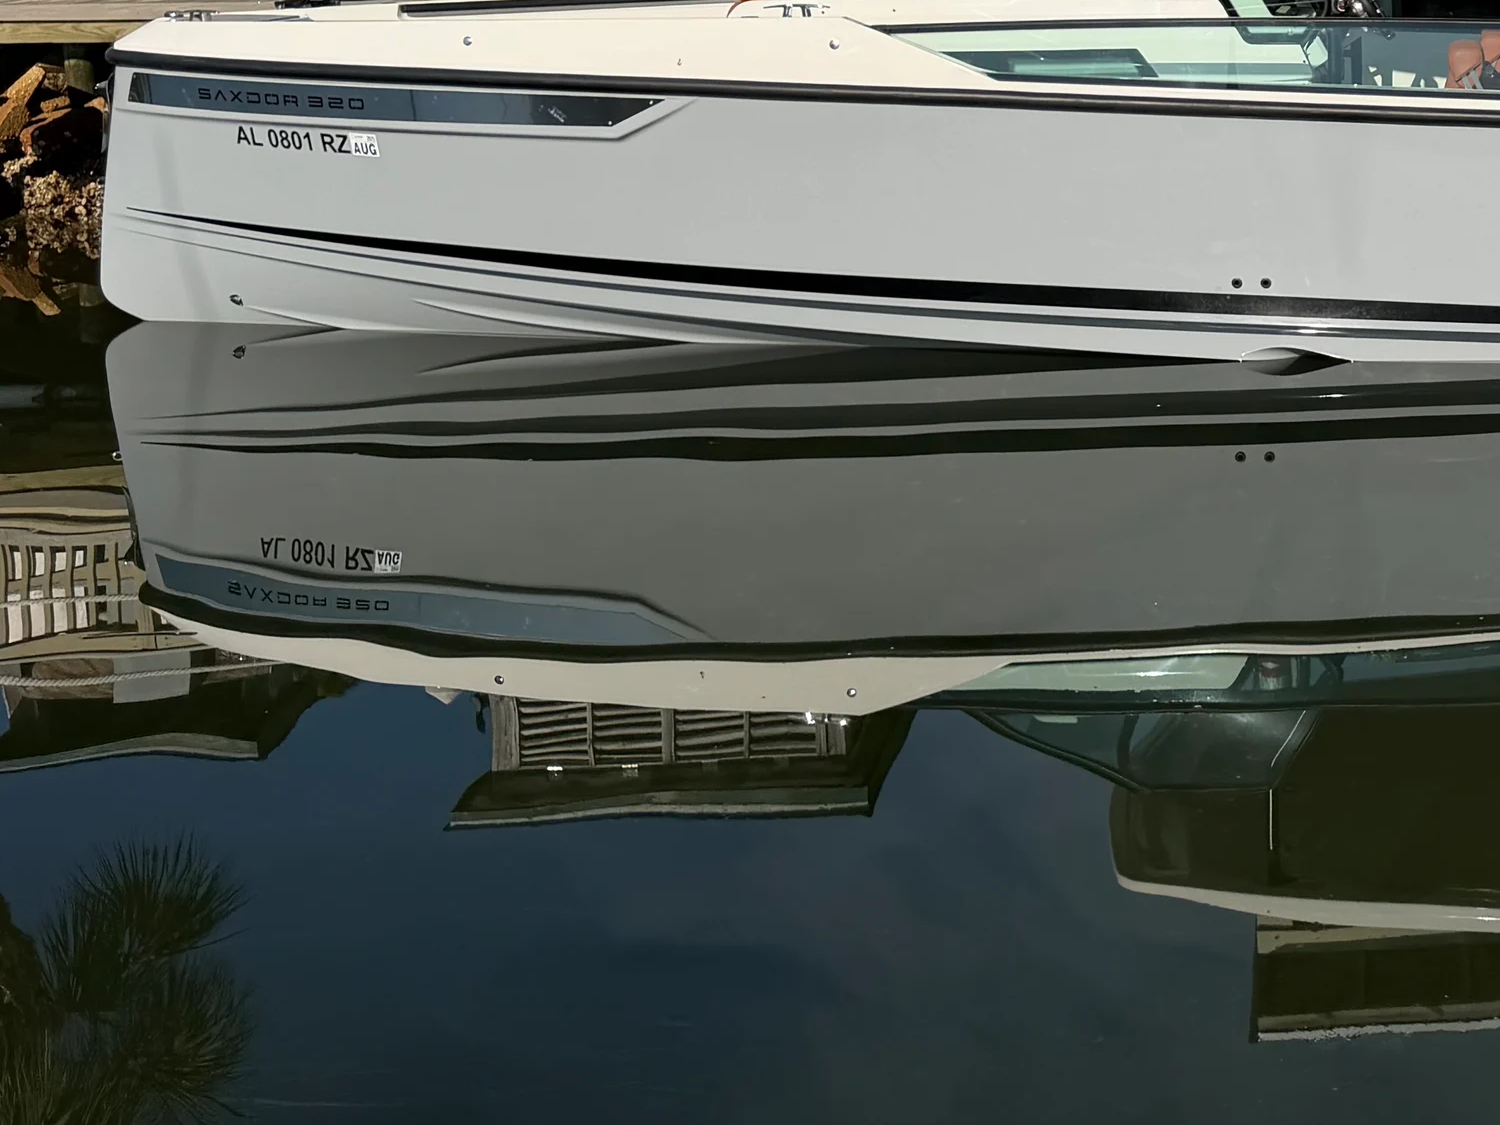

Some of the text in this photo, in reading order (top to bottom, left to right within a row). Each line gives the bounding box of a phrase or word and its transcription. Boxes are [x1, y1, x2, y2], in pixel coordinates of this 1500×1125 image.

[198, 87, 365, 110] SAXDOR 320
[237, 126, 352, 154] AL 0801 RZ
[354, 141, 378, 156] AUG
